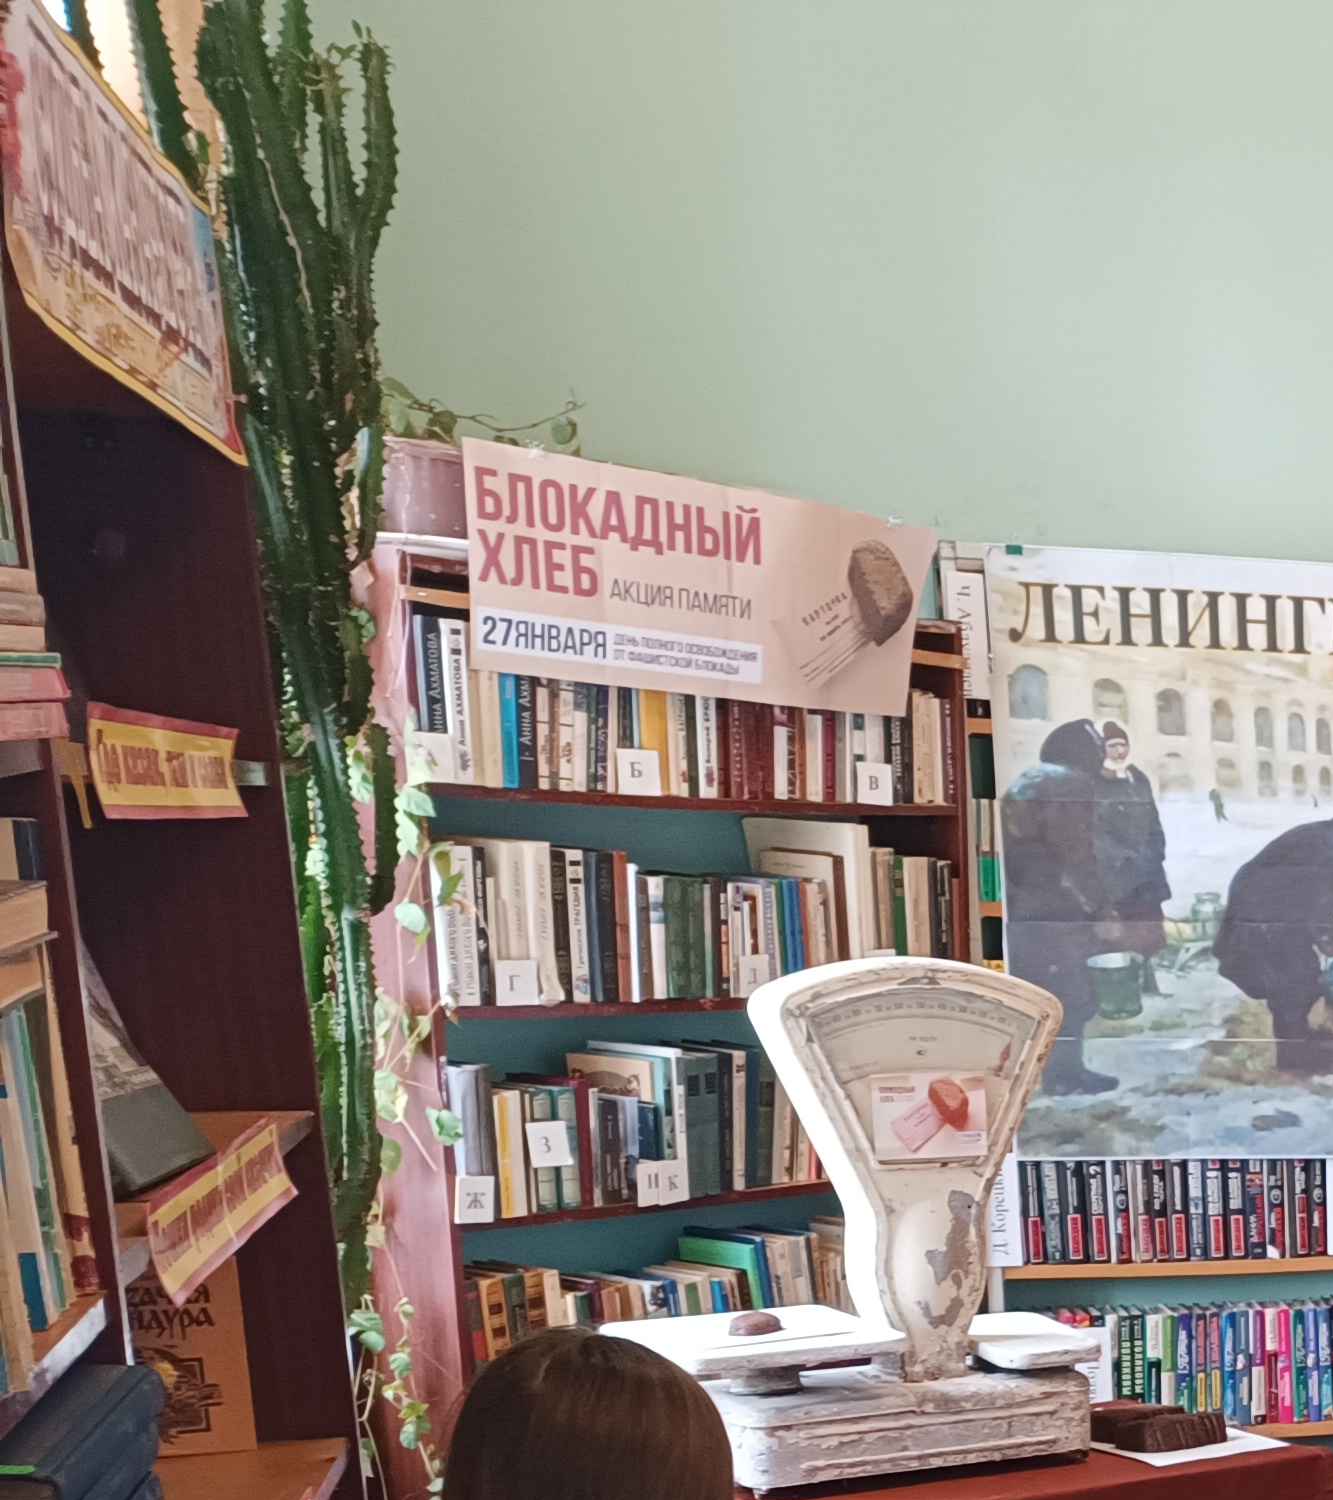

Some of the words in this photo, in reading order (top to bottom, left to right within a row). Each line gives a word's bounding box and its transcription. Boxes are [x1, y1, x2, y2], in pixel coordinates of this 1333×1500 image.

[474, 466, 762, 565] БЛОКАДНЫЙ
[477, 528, 599, 598] ХЛЕБ
[610, 577, 674, 609] АКЦИЯ
[678, 586, 752, 621] ПАМЯТИ
[482, 614, 607, 659] 27ЯНВАРЯ
[613, 632, 640, 649] ДЕНЬ
[642, 635, 681, 655] ПОЛНОГО
[683, 637, 758, 664] ОСВОБОЖДЕНИЯ
[425, 632, 442, 699] АХМАТОВА
[613, 649, 625, 662] ОТ
[627, 652, 692, 670] ФАШИСТСКОЙ
[694, 657, 741, 677] БЛОКАДЫ
[451, 657, 464, 716] АХМАТОВА
[520, 711, 533, 745] АННА
[629, 761, 643, 778] Б
[868, 775, 879, 791] В
[508, 975, 521, 992] Г
[538, 1136, 551, 1154] З
[667, 1174, 679, 1191] К
[465, 1191, 486, 1209] Ж
[1121, 1341, 1132, 1396] ПОЛЯКОВЫ
[1133, 1339, 1144, 1394] ПОЛЯКОВЫ
